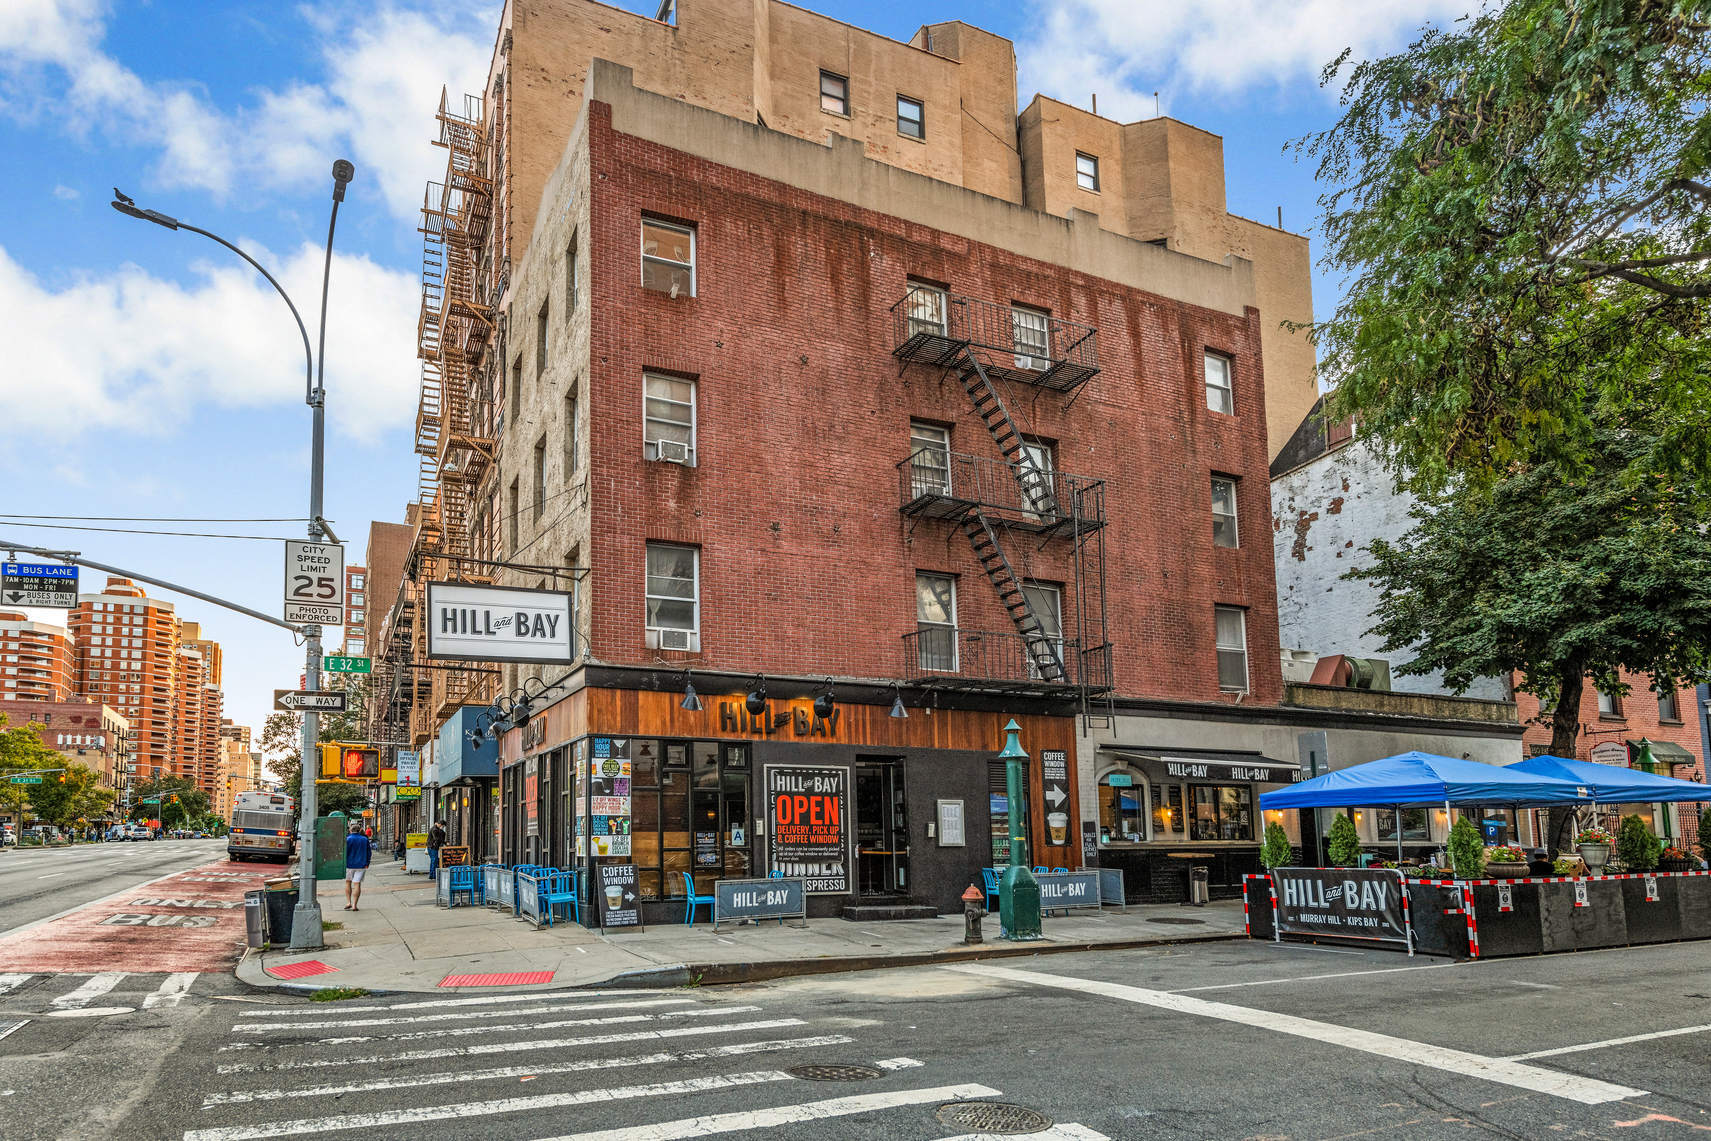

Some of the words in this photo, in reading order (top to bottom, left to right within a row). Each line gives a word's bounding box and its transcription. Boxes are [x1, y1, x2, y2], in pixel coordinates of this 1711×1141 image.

[302, 545, 326, 554] CITY
[296, 554, 331, 564] SPEED
[23, 566, 43, 575] BUS
[46, 568, 73, 576] LANE
[300, 564, 328, 573] LIMIT
[293, 575, 336, 599] 25
[299, 606, 329, 614] PHOTO
[289, 612, 338, 622] ENFORCED
[441, 607, 497, 635] HILL
[493, 616, 514, 629] and
[515, 612, 560, 639] BAY
[329, 658, 335, 670] E
[340, 658, 353, 671] 32
[285, 696, 306, 705] ONE
[315, 697, 337, 706] WAY
[792, 706, 841, 737] BAY
[1043, 751, 1065, 760] COFFEE
[1043, 760, 1065, 768] WINDOW
[1167, 762, 1188, 776] HILL
[1192, 764, 1208, 778] BAY
[1231, 767, 1250, 780] HILL
[1254, 768, 1270, 781] BAY
[776, 775, 806, 792] HILL
[814, 776, 838, 793] BAY
[776, 794, 839, 825] OPEN
[1378, 818, 1392, 830] BAY
[812, 825, 830, 835] PICK
[830, 825, 840, 835] UP
[1489, 826, 1495, 836] P
[733, 831, 743, 841] A
[777, 834, 783, 844] &
[784, 834, 809, 844] COFFEE
[809, 834, 839, 844] WINDOW
[602, 865, 634, 877] COFFEE
[603, 876, 634, 886] WINDOW
[806, 880, 845, 891] SPRESSO
[1041, 883, 1063, 898] HILL
[1068, 882, 1086, 897] BAY
[1283, 878, 1330, 908] HILL
[1325, 885, 1343, 901] and
[1343, 880, 1387, 912] BAY
[733, 891, 759, 908] HILL
[766, 889, 788, 906] BAY
[98, 913, 218, 928] BUS
[1299, 913, 1327, 924] MURRAY
[1327, 915, 1342, 925] HILL
[1347, 916, 1363, 926] KIPS
[1363, 917, 1378, 927] BAY
